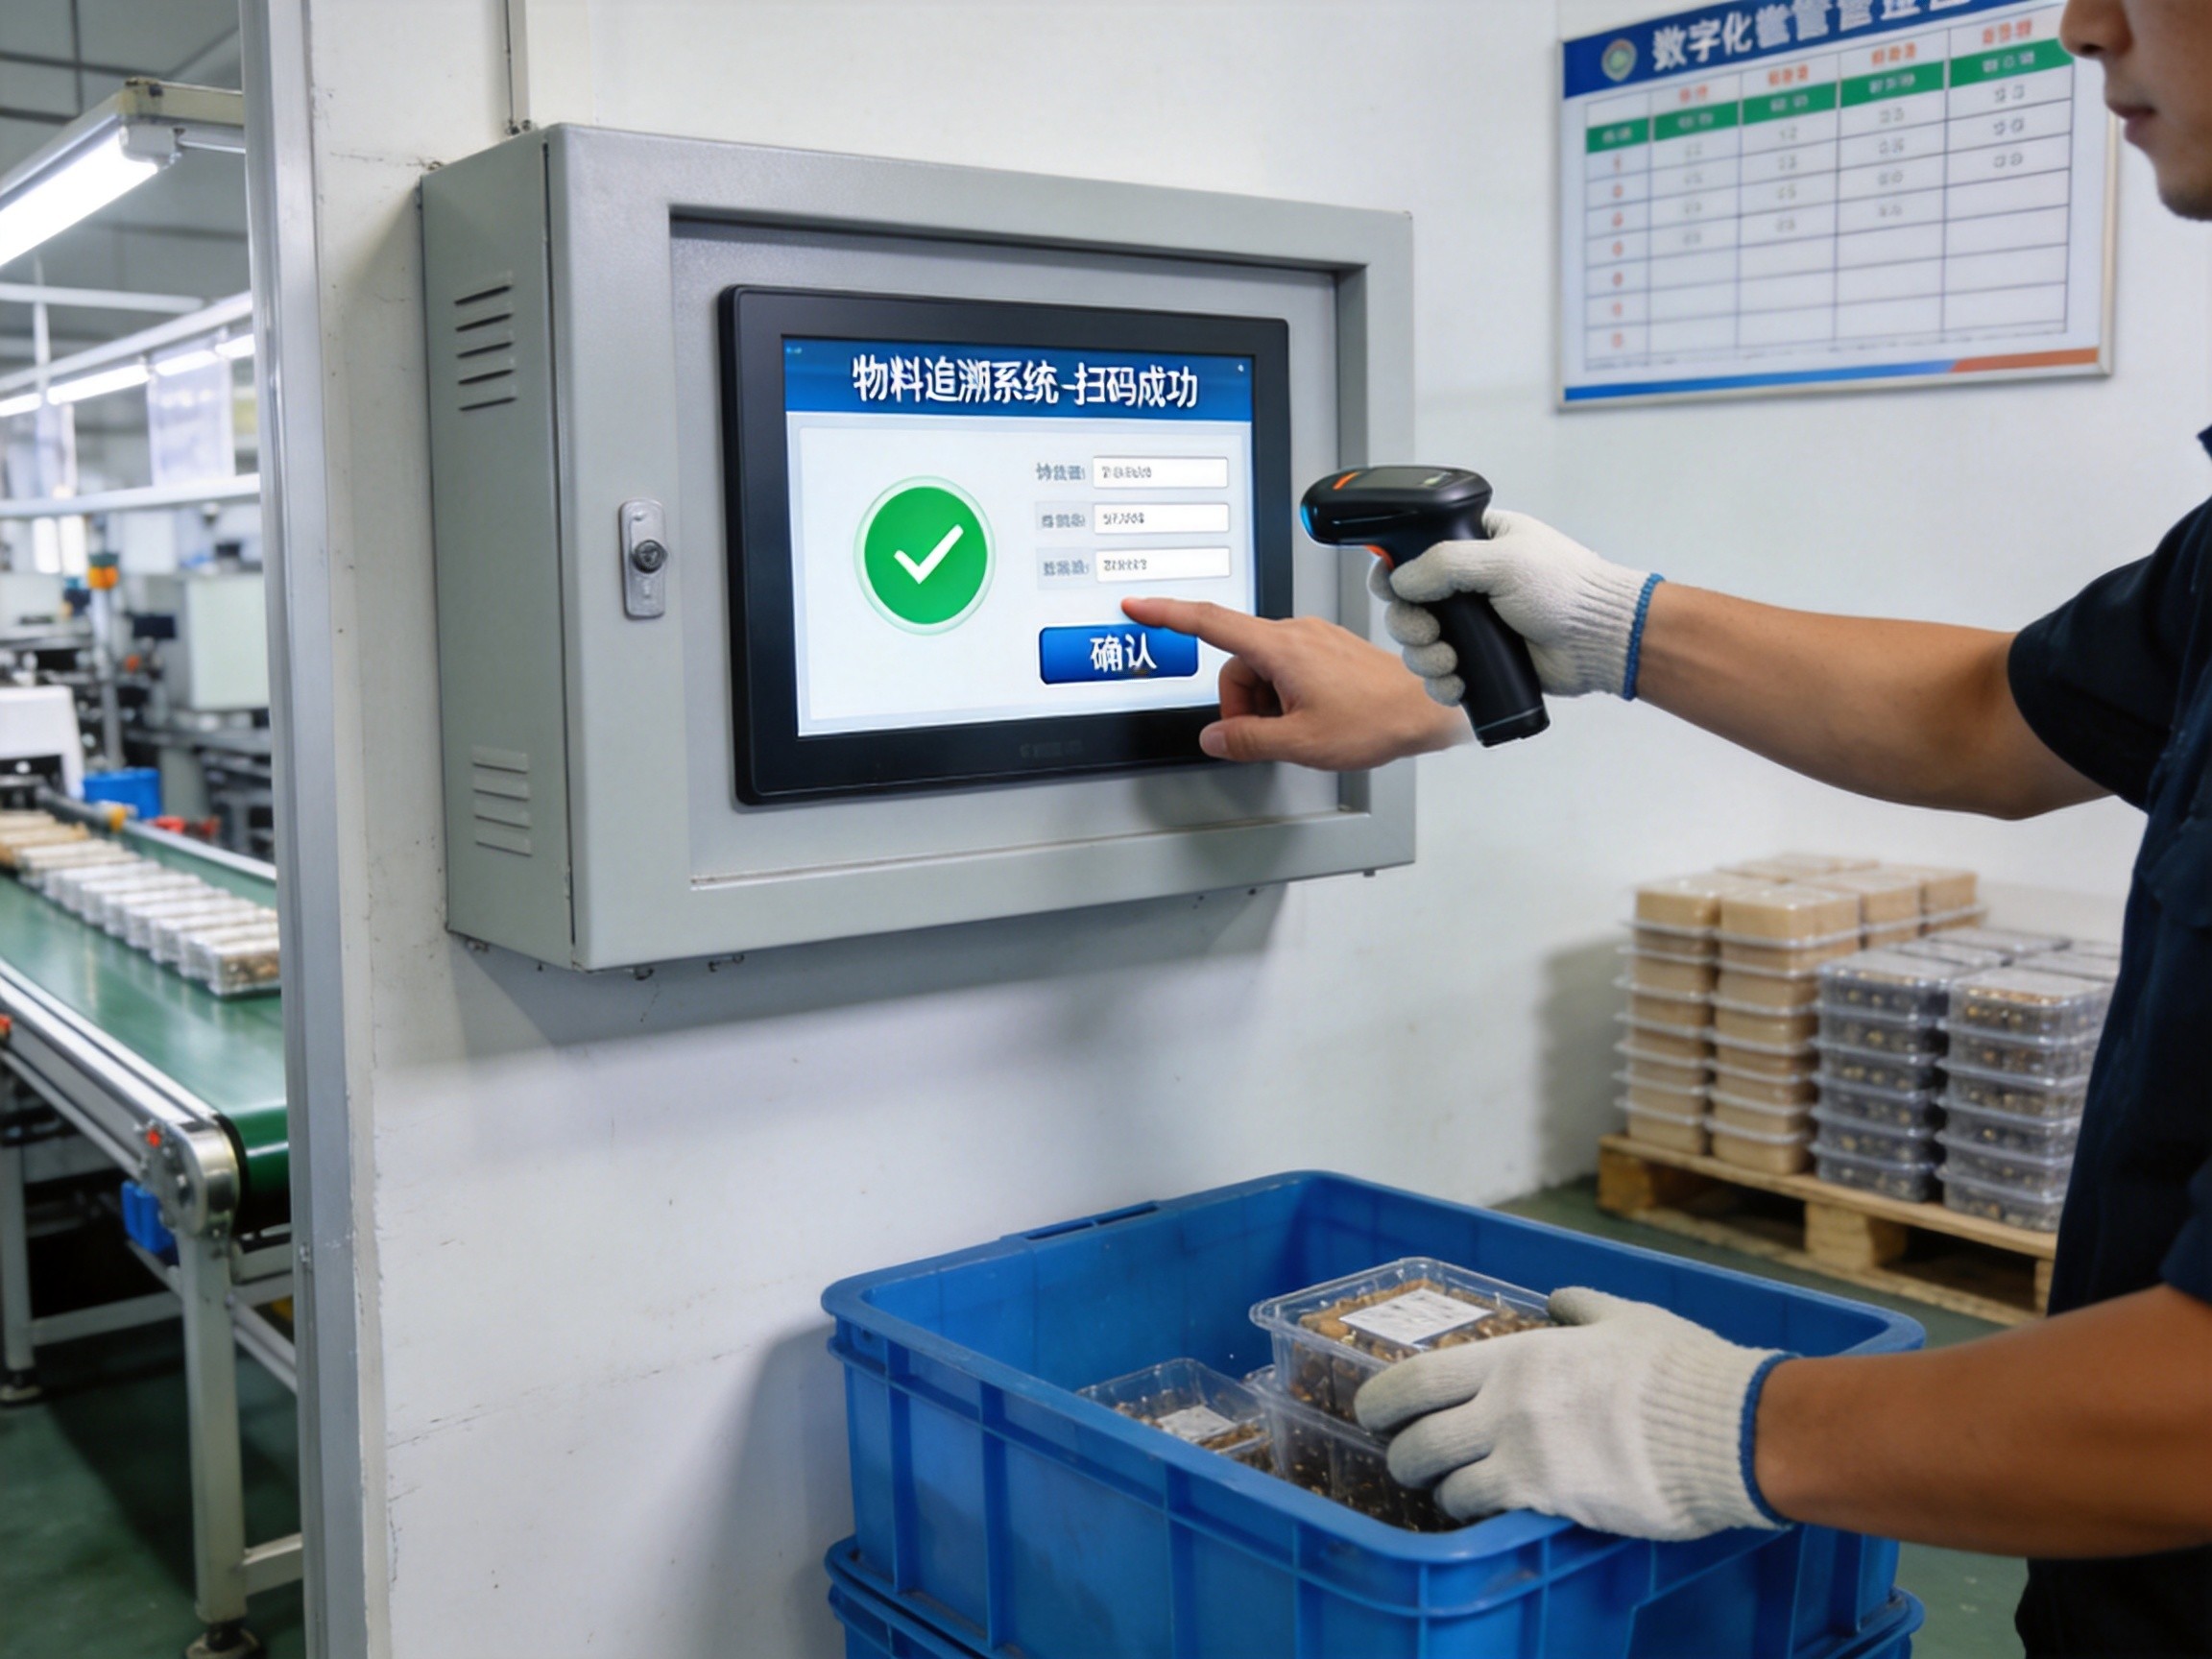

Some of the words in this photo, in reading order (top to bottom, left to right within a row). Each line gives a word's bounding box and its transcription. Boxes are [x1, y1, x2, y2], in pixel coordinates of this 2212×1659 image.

[853, 353, 1198, 409] 物料追溯系统-扫码成功
[1089, 632, 1157, 672] 确认
